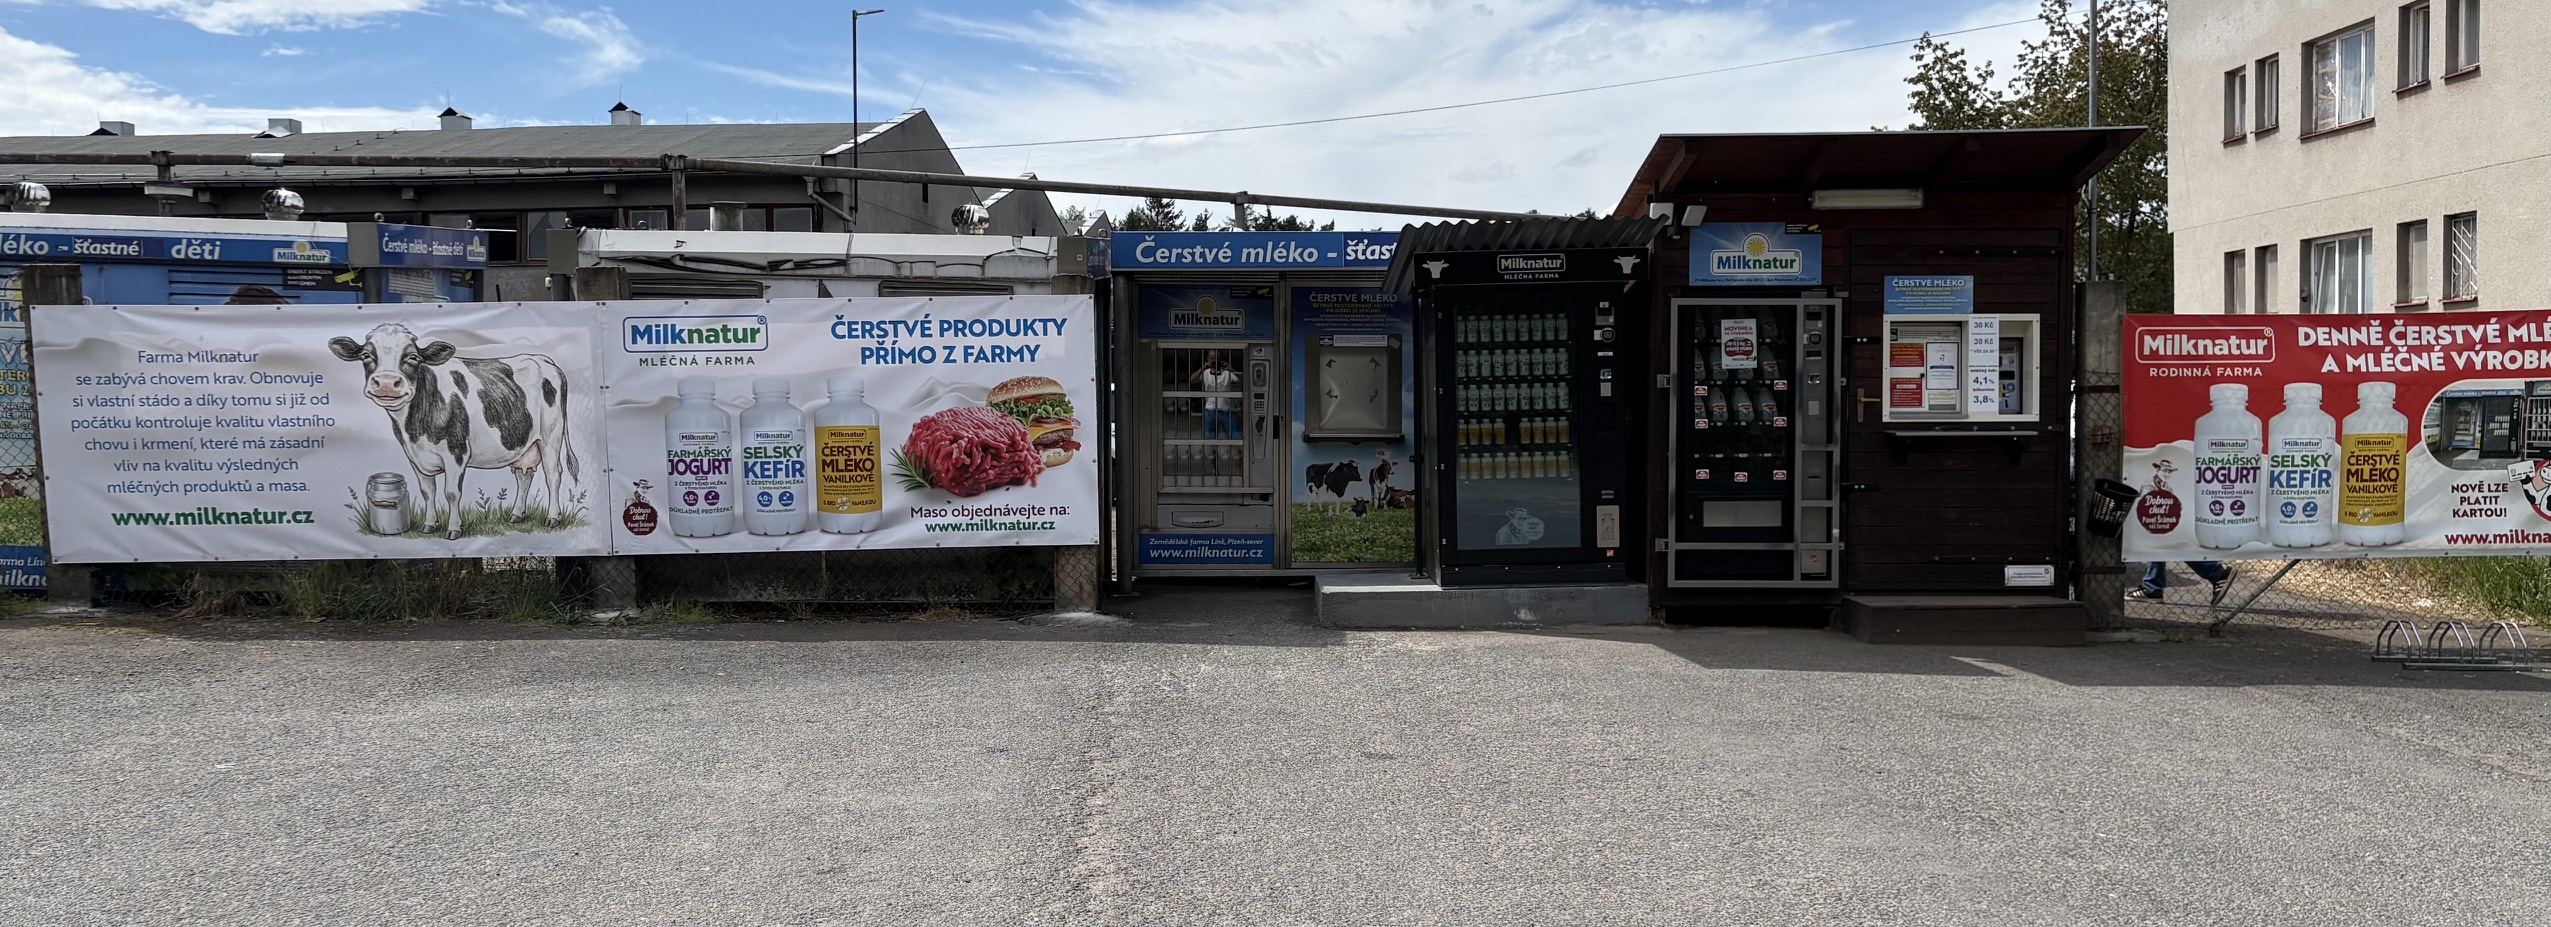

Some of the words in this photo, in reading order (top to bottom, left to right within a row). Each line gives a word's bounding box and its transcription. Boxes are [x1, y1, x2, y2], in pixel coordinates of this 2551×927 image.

[74, 238, 140, 256] šťastné
[171, 239, 221, 260] děti
[382, 233, 408, 253] Čerstvé
[408, 237, 428, 254] mléko
[1136, 235, 1232, 264] Čerstvé
[1240, 240, 1318, 264] mléko
[1346, 239, 1397, 260] šťast
[276, 251, 327, 262] Milknatur
[1500, 258, 1562, 269] Milknatur
[1717, 256, 1796, 270] Milknatur
[1892, 278, 1932, 286] ČERSTVÉ
[1934, 278, 1964, 286] MLÉKO
[1309, 291, 1358, 302] ČERSTVÉ
[830, 314, 932, 340] ČERSTVÉ
[939, 318, 1068, 338] PRODUKTY
[1174, 313, 1240, 326] Milknatur
[631, 324, 760, 344] Milknatur
[2298, 320, 2384, 346] DENNĚ
[2389, 318, 2501, 346] ČERSTVÉ
[2508, 316, 2551, 343] MLÉ
[861, 340, 936, 364] PŘÍMO
[943, 346, 957, 364] Z
[964, 344, 1041, 364] FARMY
[2144, 334, 2267, 356] Milknatur
[138, 351, 184, 363] Farma
[188, 350, 258, 362] Milknatur
[639, 355, 698, 366] MLÉČNÁ
[706, 356, 755, 366] FARMA
[2321, 353, 2340, 373] A
[2346, 346, 2446, 372] MLÉČNÉ
[2450, 344, 2551, 371] VÝROBK
[2150, 366, 2212, 377] RODINNÁ
[2217, 367, 2262, 376] FARMA
[76, 376, 92, 386] se
[96, 373, 146, 388] zabývá
[150, 373, 210, 385] chovem
[214, 372, 246, 384] krav.
[250, 372, 324, 387] Obnovuje
[1973, 376, 1994, 385] 4,1%
[73, 395, 83, 407] si
[87, 394, 134, 407] vlastní
[139, 394, 180, 407] stádo
[184, 398, 192, 406] a
[196, 394, 228, 409] díky
[232, 395, 272, 406] tomu
[276, 394, 286, 406] si
[290, 393, 306, 408] již
[310, 393, 330, 406] od
[1974, 396, 1994, 404] 3,8%
[71, 416, 131, 432] počátku
[136, 416, 212, 431] kontroluje
[216, 416, 264, 428] kvalitu
[268, 414, 336, 427] vlastního
[85, 438, 129, 450] chovu
[134, 438, 137, 450] i
[142, 437, 197, 452] krmení,
[200, 437, 238, 450] které
[242, 437, 266, 449] má
[270, 436, 325, 448] zásadní
[744, 444, 804, 459] SELSKÝ
[822, 442, 874, 457] ČERSTVÉ
[668, 446, 732, 458] FARMÁŘSKÝ
[2347, 450, 2400, 466] ČERSTVÉ
[114, 459, 138, 472] vliv
[143, 462, 160, 471] na
[164, 459, 212, 471] kvalitu
[217, 458, 298, 474] výsledných
[668, 458, 732, 476] JOGURT
[822, 456, 875, 473] MLÉKO
[2196, 454, 2262, 466] FARMÁŘSKÝ
[2270, 452, 2332, 468] SELSKÝ
[744, 459, 805, 478] KEFÍR
[2196, 466, 2261, 484] JOGURT
[2346, 464, 2400, 482] MLÉKO
[823, 472, 874, 484] VANILKOVÉ
[2270, 468, 2332, 488] KEFÍR
[107, 480, 179, 496] mléčných
[184, 479, 252, 496] produktů
[256, 482, 264, 492] a
[269, 482, 310, 492] masa.
[2346, 482, 2398, 494] VANILKOVÉ
[2451, 480, 2484, 494] NOVĚ
[2488, 483, 2508, 492] LZE
[2144, 494, 2174, 506] Dobrou
[2460, 496, 2500, 506] PLATIT
[112, 506, 314, 526] www.milknatur.cz
[629, 506, 650, 514] Dobrou
[910, 506, 948, 518] Maso
[952, 504, 1046, 520] objednávejte
[1050, 506, 1070, 516] na:
[2452, 508, 2507, 518] KARTOU!
[925, 519, 1056, 532] www.milknatur.cz
[2444, 529, 2551, 544] www.milkna
[1150, 546, 1264, 558] www.milknatur.cz
